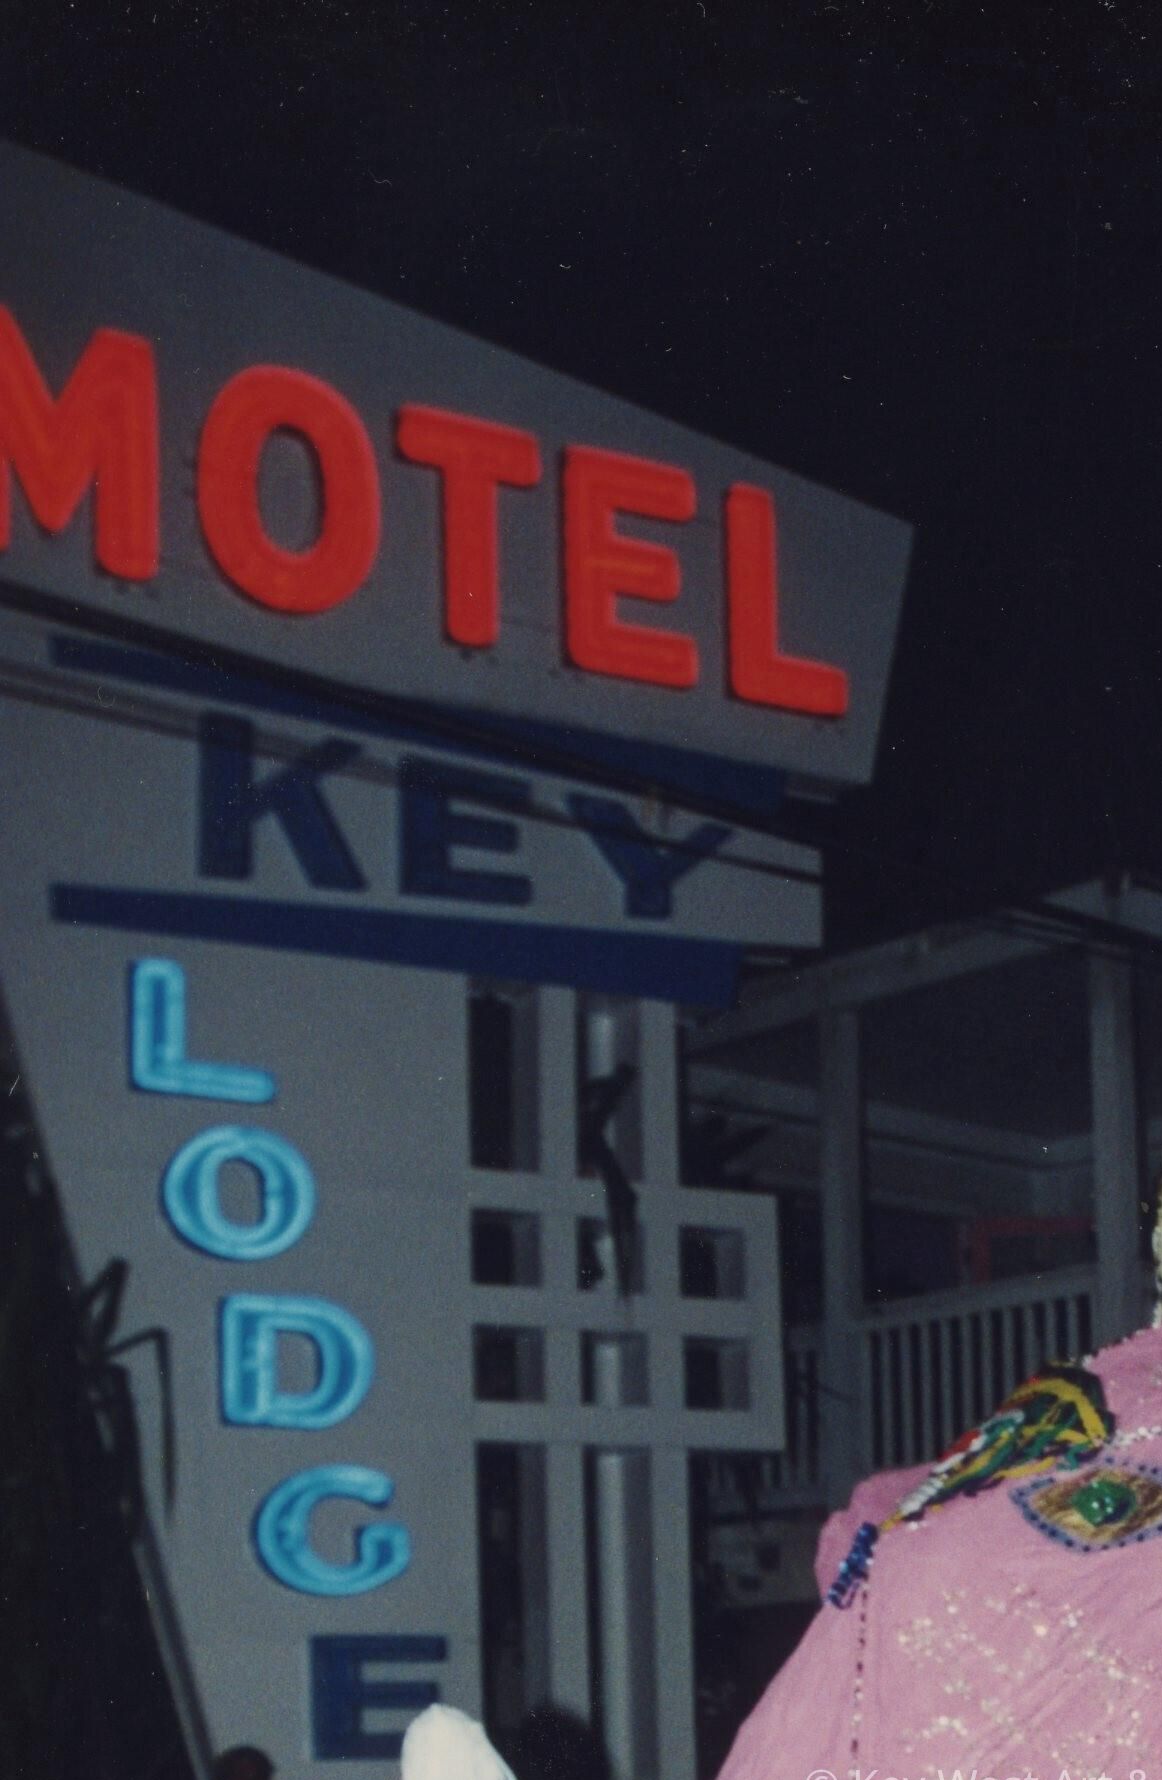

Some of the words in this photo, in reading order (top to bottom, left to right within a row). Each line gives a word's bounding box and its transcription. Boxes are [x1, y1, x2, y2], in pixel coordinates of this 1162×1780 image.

[0, 302, 848, 717] MOTEL
[198, 711, 735, 920] KEY
[129, 957, 448, 1762] LODGE
